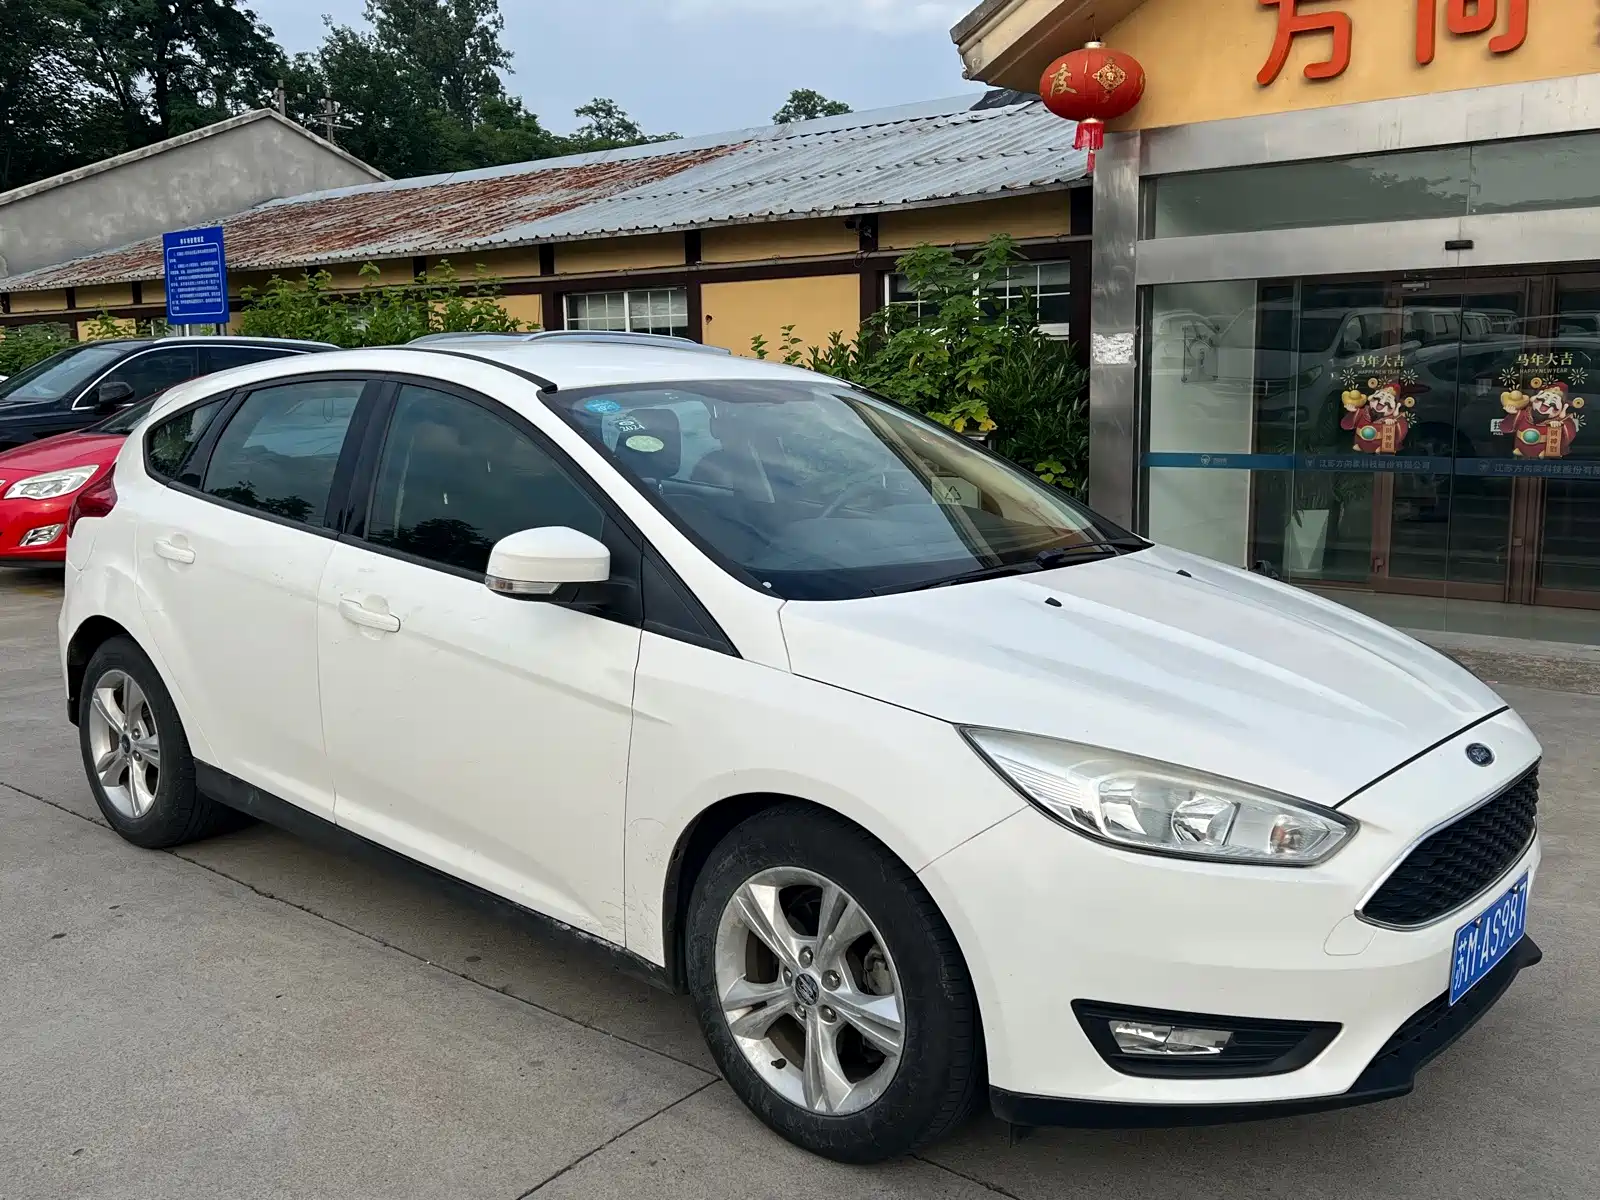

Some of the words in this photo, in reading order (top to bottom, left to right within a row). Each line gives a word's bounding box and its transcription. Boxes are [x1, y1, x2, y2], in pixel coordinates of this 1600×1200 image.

[1356, 355, 1404, 367] 马年大吉
[1516, 352, 1573, 366] 马年大吉
